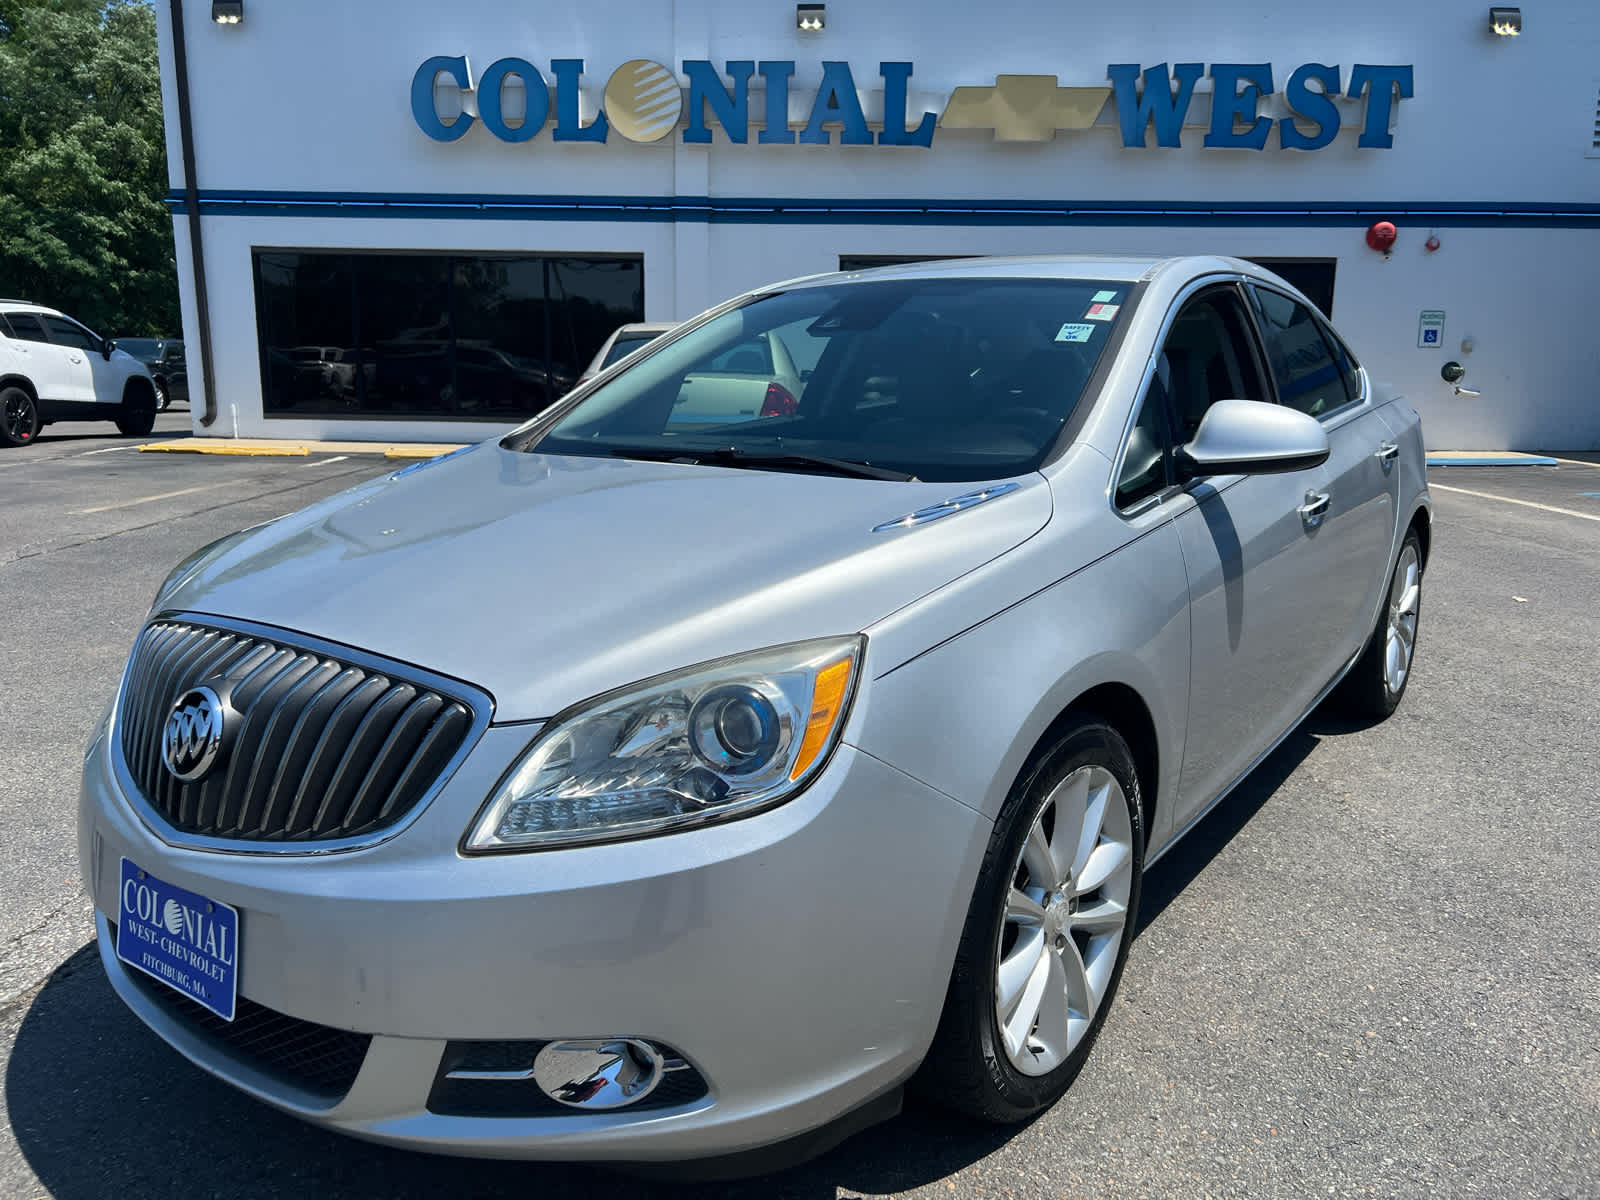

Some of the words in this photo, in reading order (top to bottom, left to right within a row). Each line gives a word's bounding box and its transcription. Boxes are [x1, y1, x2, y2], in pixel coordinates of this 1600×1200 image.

[410, 55, 937, 148] COLONIAL
[1107, 62, 1414, 150] WEST
[123, 878, 233, 966] COLONIAL
